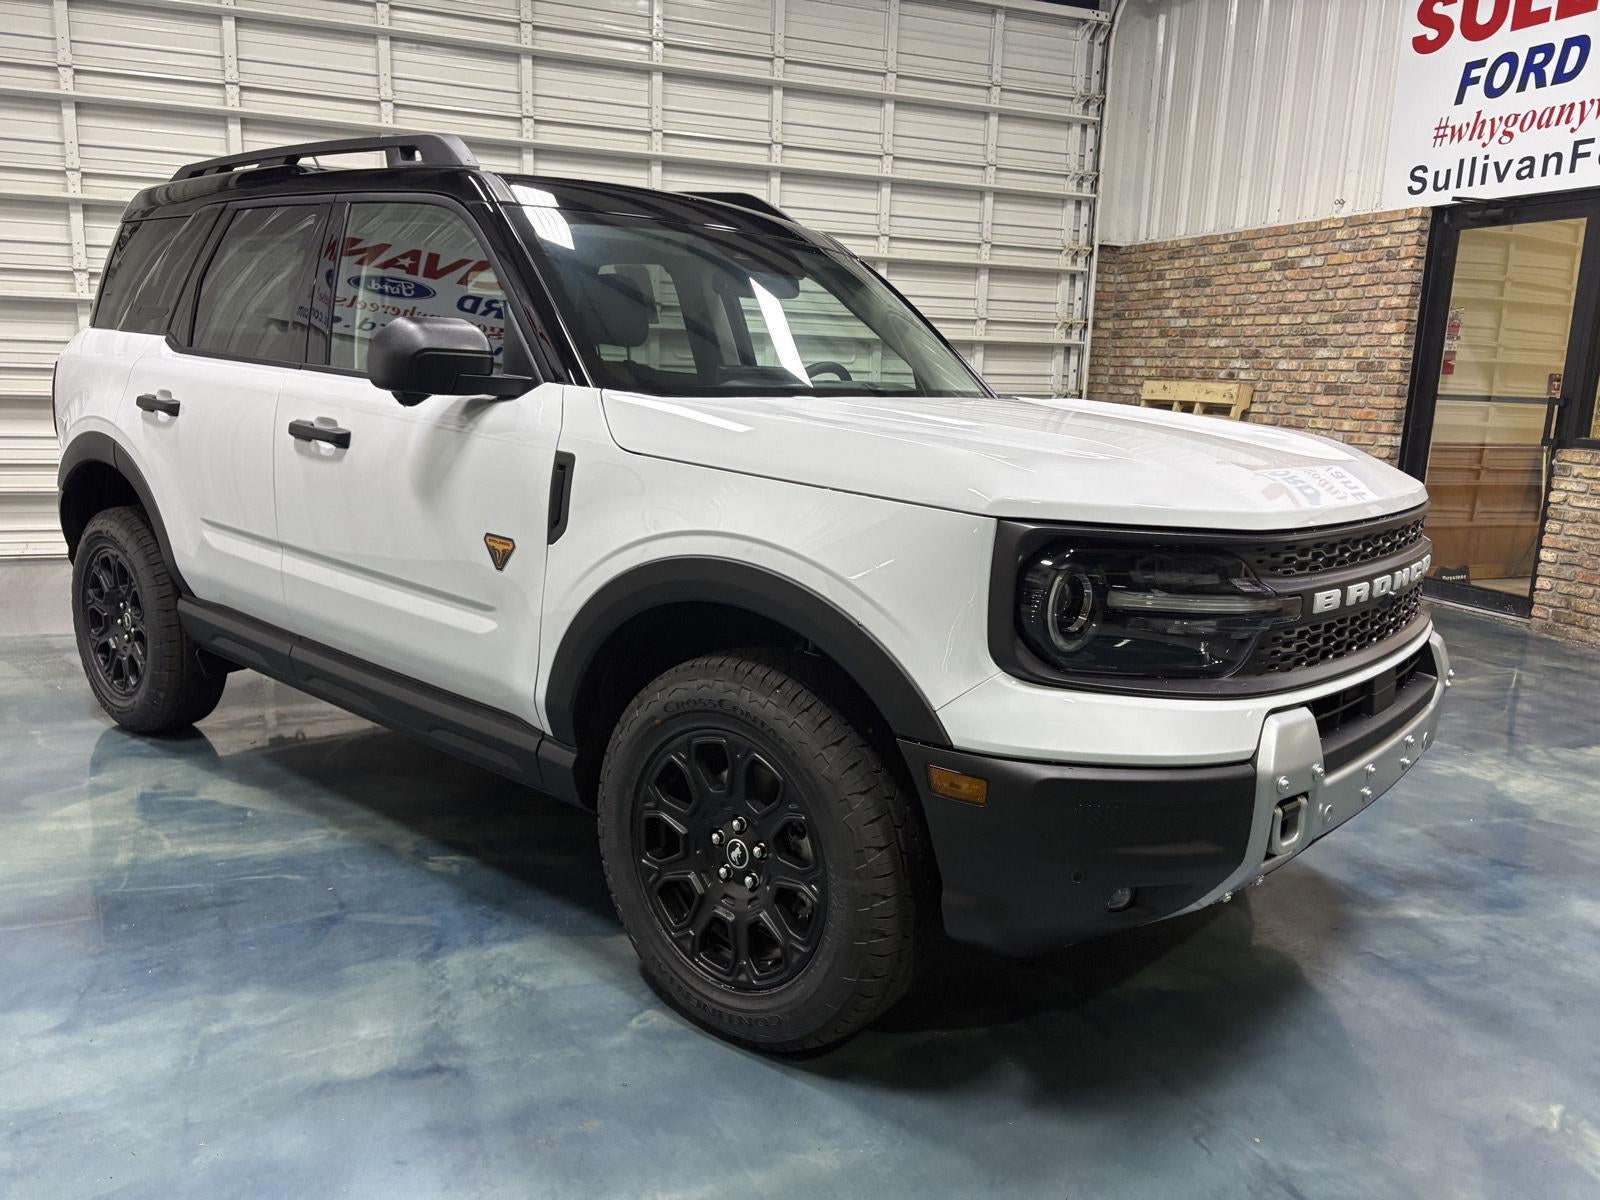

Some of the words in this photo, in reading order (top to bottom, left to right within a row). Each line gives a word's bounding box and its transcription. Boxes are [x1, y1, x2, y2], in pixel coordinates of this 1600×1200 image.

[1454, 34, 1591, 106] FORD
[1407, 137, 1600, 195] SullivanF
[1312, 554, 1432, 614] BRONCO
